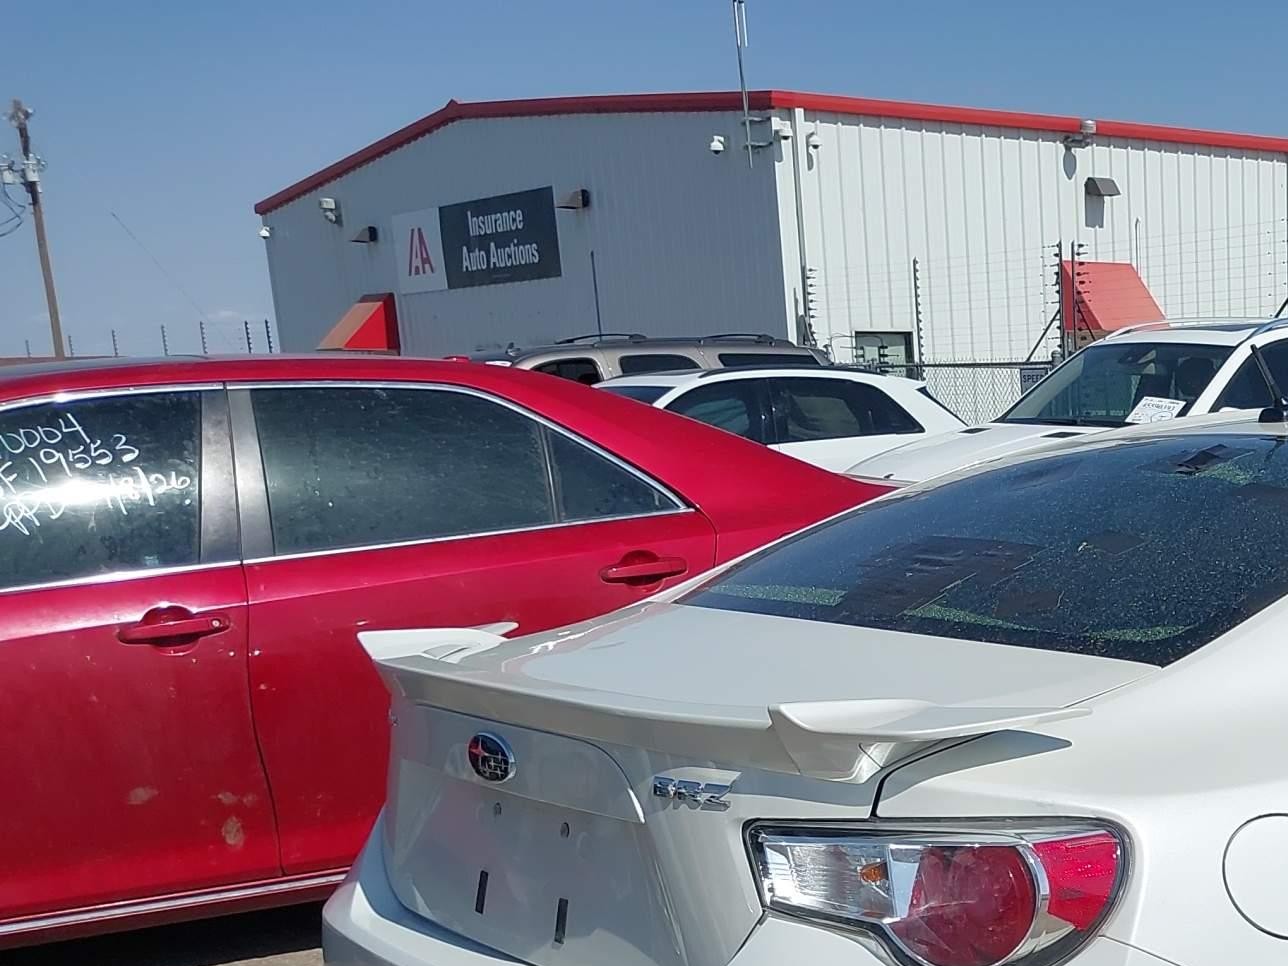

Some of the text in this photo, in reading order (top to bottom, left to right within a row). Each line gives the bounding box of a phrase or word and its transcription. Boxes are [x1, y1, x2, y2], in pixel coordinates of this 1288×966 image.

[466, 208, 524, 237] Insurance
[462, 238, 540, 272] Auto Auctions
[653, 775, 732, 804] BRZ
